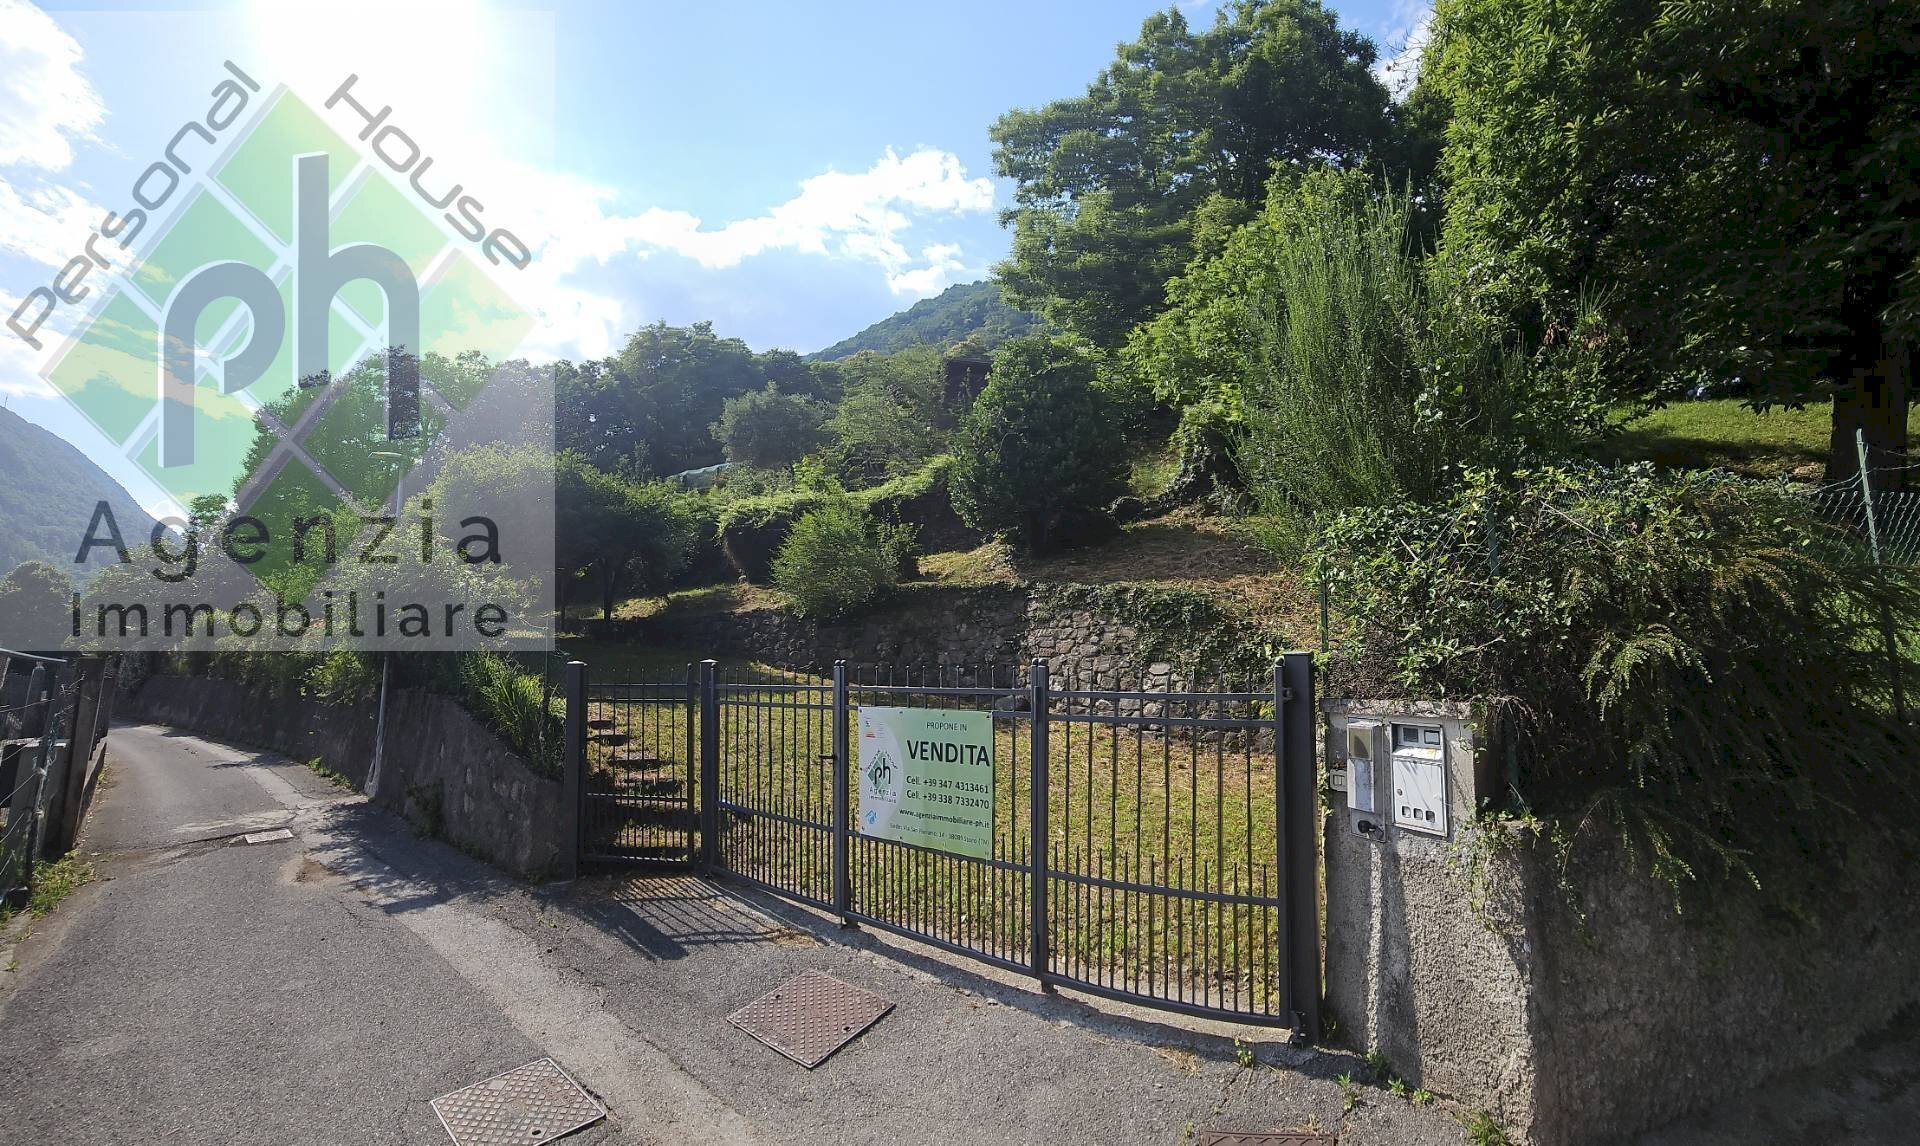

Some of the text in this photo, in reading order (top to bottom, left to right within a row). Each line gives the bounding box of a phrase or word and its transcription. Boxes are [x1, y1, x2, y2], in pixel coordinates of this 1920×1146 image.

[926, 721, 967, 731] PROPONE IN
[907, 740, 990, 767] VENDITA
[923, 778, 937, 787] +39
[938, 779, 952, 789] 347
[955, 782, 989, 794] 4313461
[922, 793, 937, 801] +39
[938, 794, 953, 804] 338
[955, 796, 990, 809] 7332470
